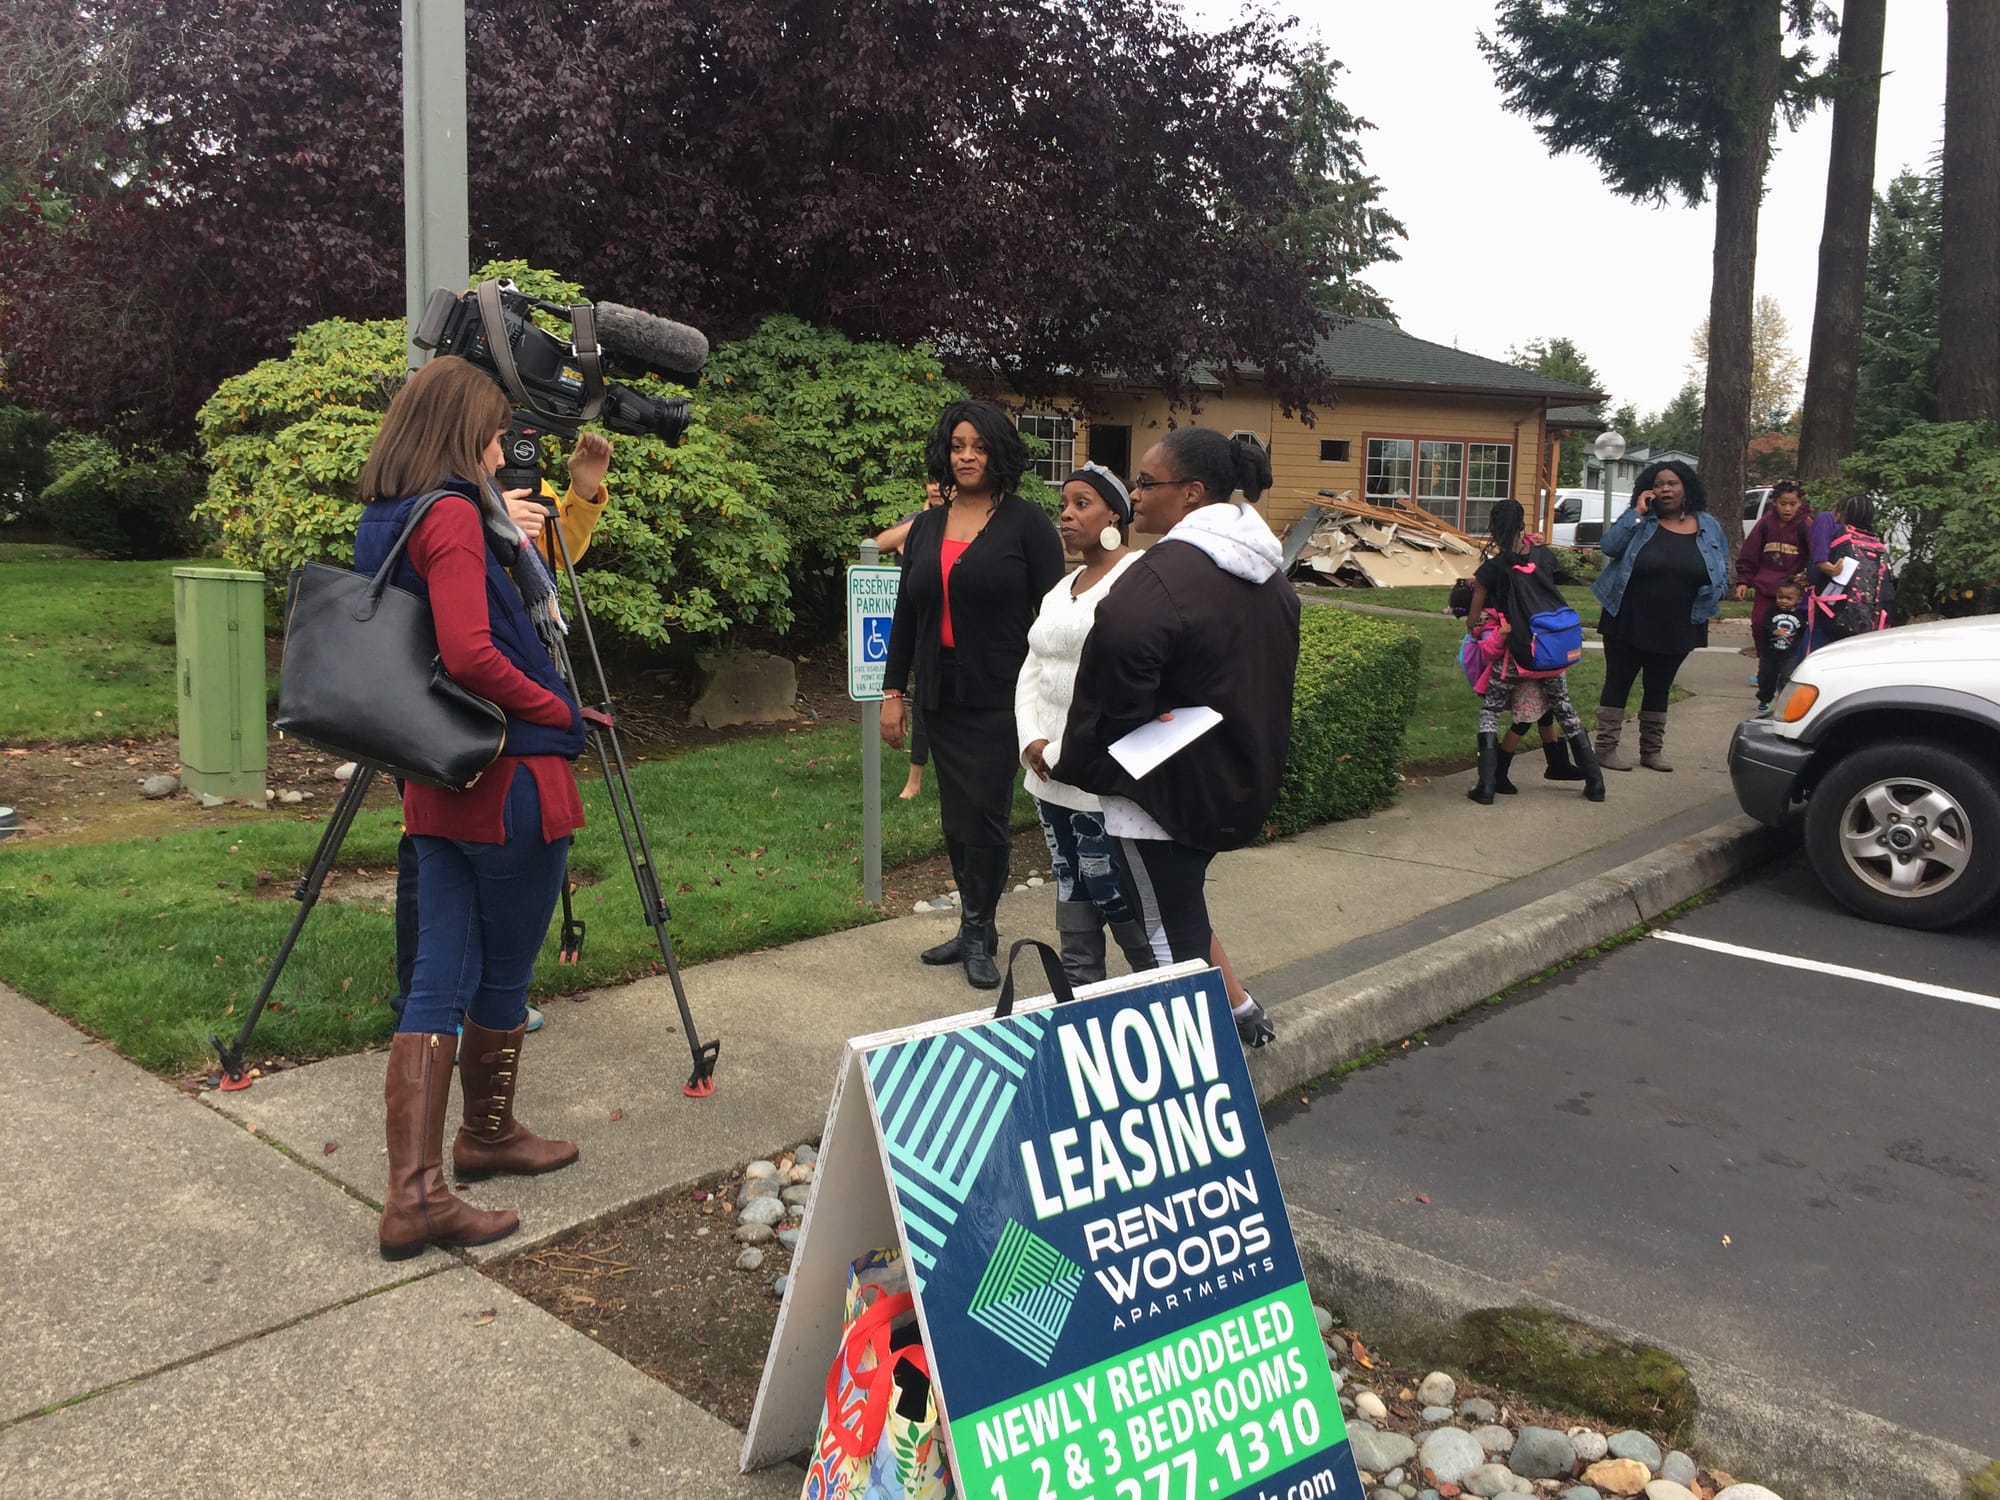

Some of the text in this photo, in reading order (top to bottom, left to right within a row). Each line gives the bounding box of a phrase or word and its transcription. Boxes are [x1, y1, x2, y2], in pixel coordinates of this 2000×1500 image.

[853, 578, 900, 595] RESERVED
[1057, 991, 1220, 1120] NOW
[1020, 1083, 1247, 1221] LEASING
[1083, 1168, 1260, 1262] RENTON
[1094, 1212, 1271, 1305] WOODS
[1113, 1256, 1274, 1331] APARTMENTS
[975, 1375, 1098, 1470] NEWLY
[1106, 1300, 1295, 1413] REMODELED
[1031, 1457, 1058, 1500] 2
[1064, 1442, 1096, 1491] &
[1097, 1428, 1122, 1476] 3
[1126, 1346, 1309, 1463] BEDROOMS
